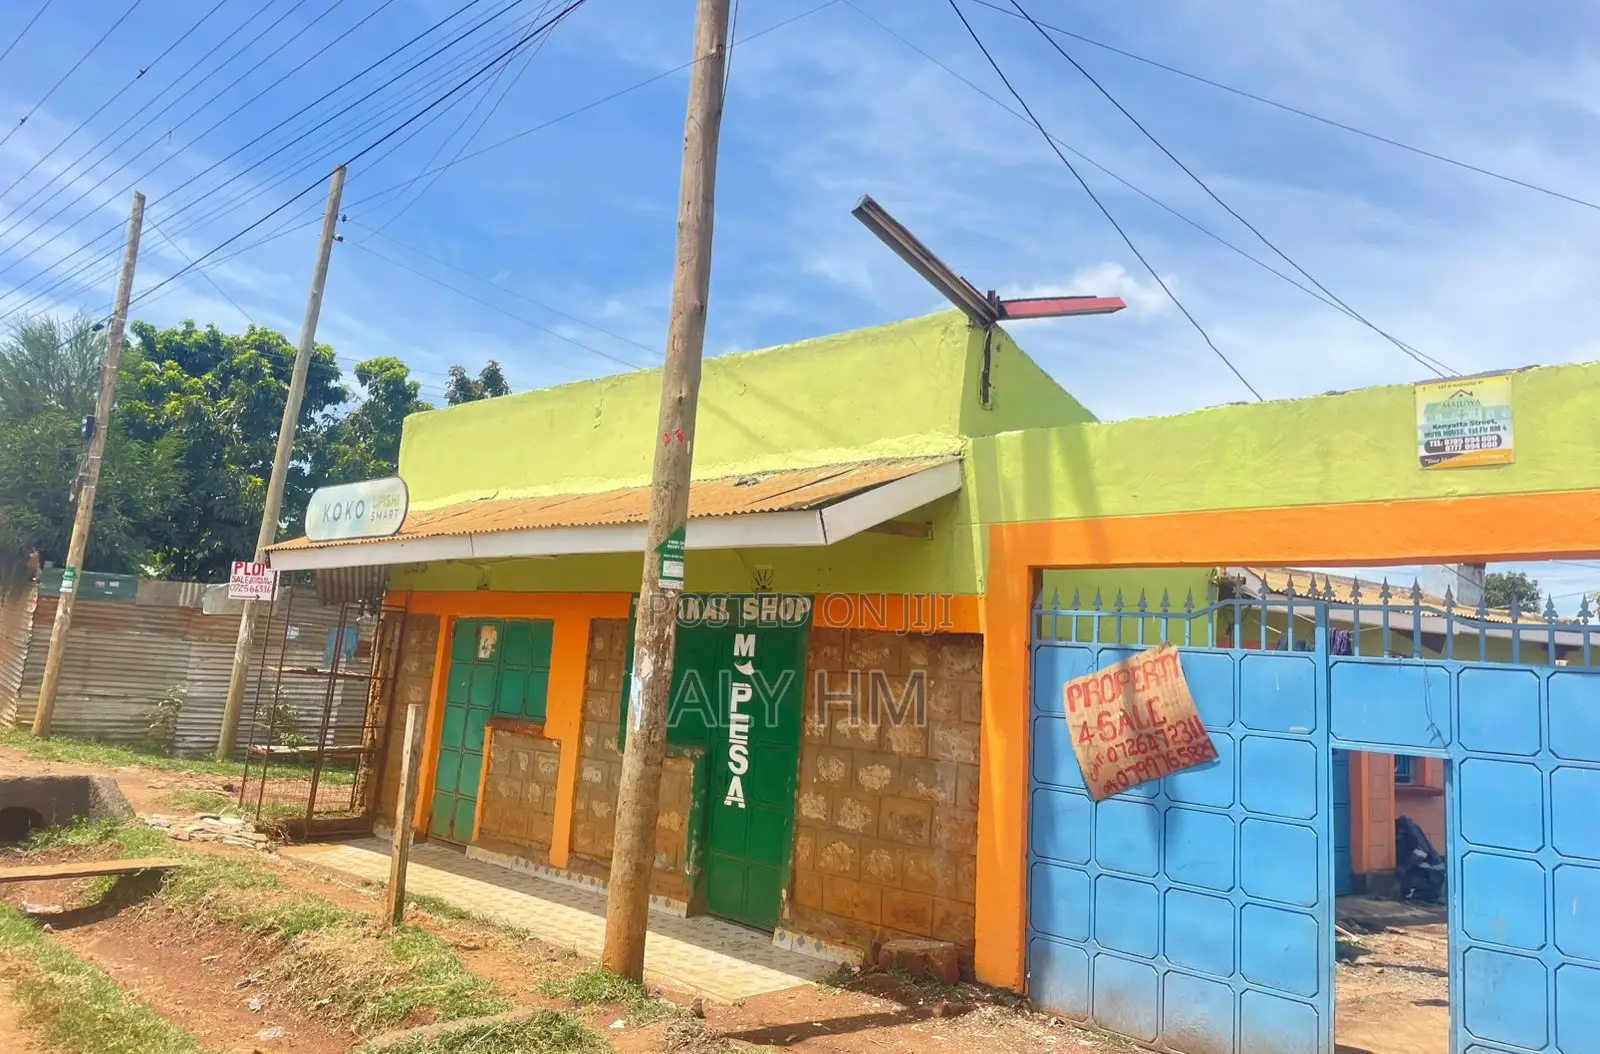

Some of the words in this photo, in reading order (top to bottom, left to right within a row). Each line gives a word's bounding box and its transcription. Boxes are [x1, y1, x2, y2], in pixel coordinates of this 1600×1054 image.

[1442, 398, 1481, 408] MAJUWA
[1432, 421, 1468, 431] Kenyatta
[322, 500, 365, 523] KOKO
[370, 508, 400, 522] SMART
[742, 597, 812, 622] SHOP
[1066, 650, 1180, 713] PROPERTY
[1078, 720, 1095, 746] 4
